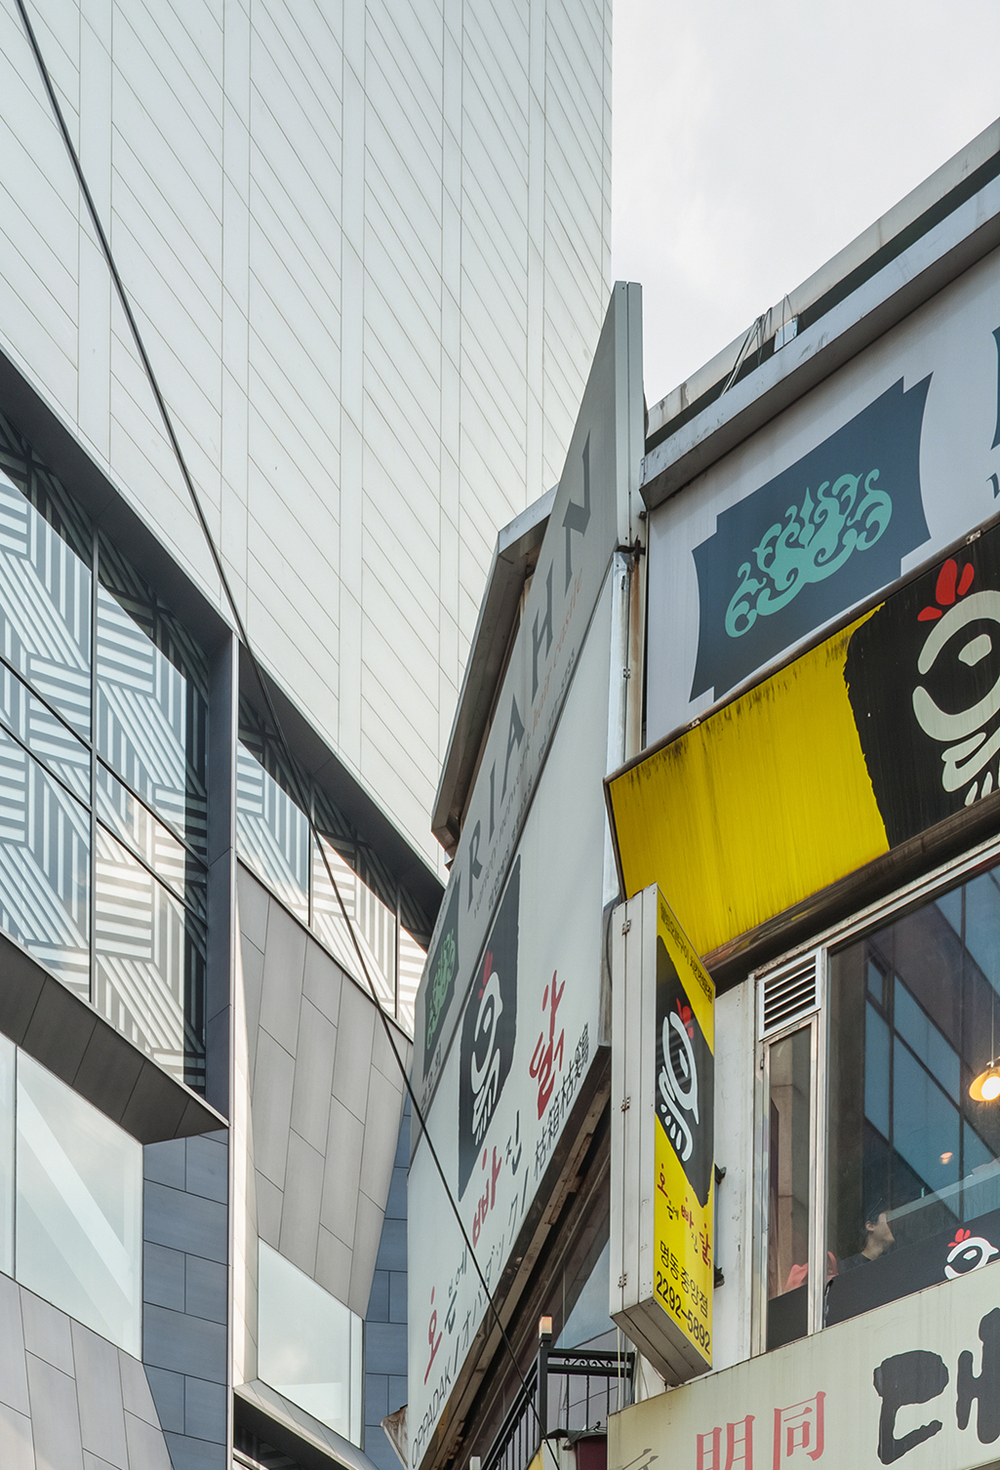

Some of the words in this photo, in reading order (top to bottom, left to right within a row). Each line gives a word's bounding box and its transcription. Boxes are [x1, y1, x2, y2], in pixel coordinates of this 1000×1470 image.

[468, 429, 591, 912] RIAHN
[529, 970, 566, 1121] 닭
[656, 1271, 711, 1355] 2292-5892
[660, 1240, 708, 1319] 명동중앙점
[411, 1370, 452, 1470] OPPADAK
